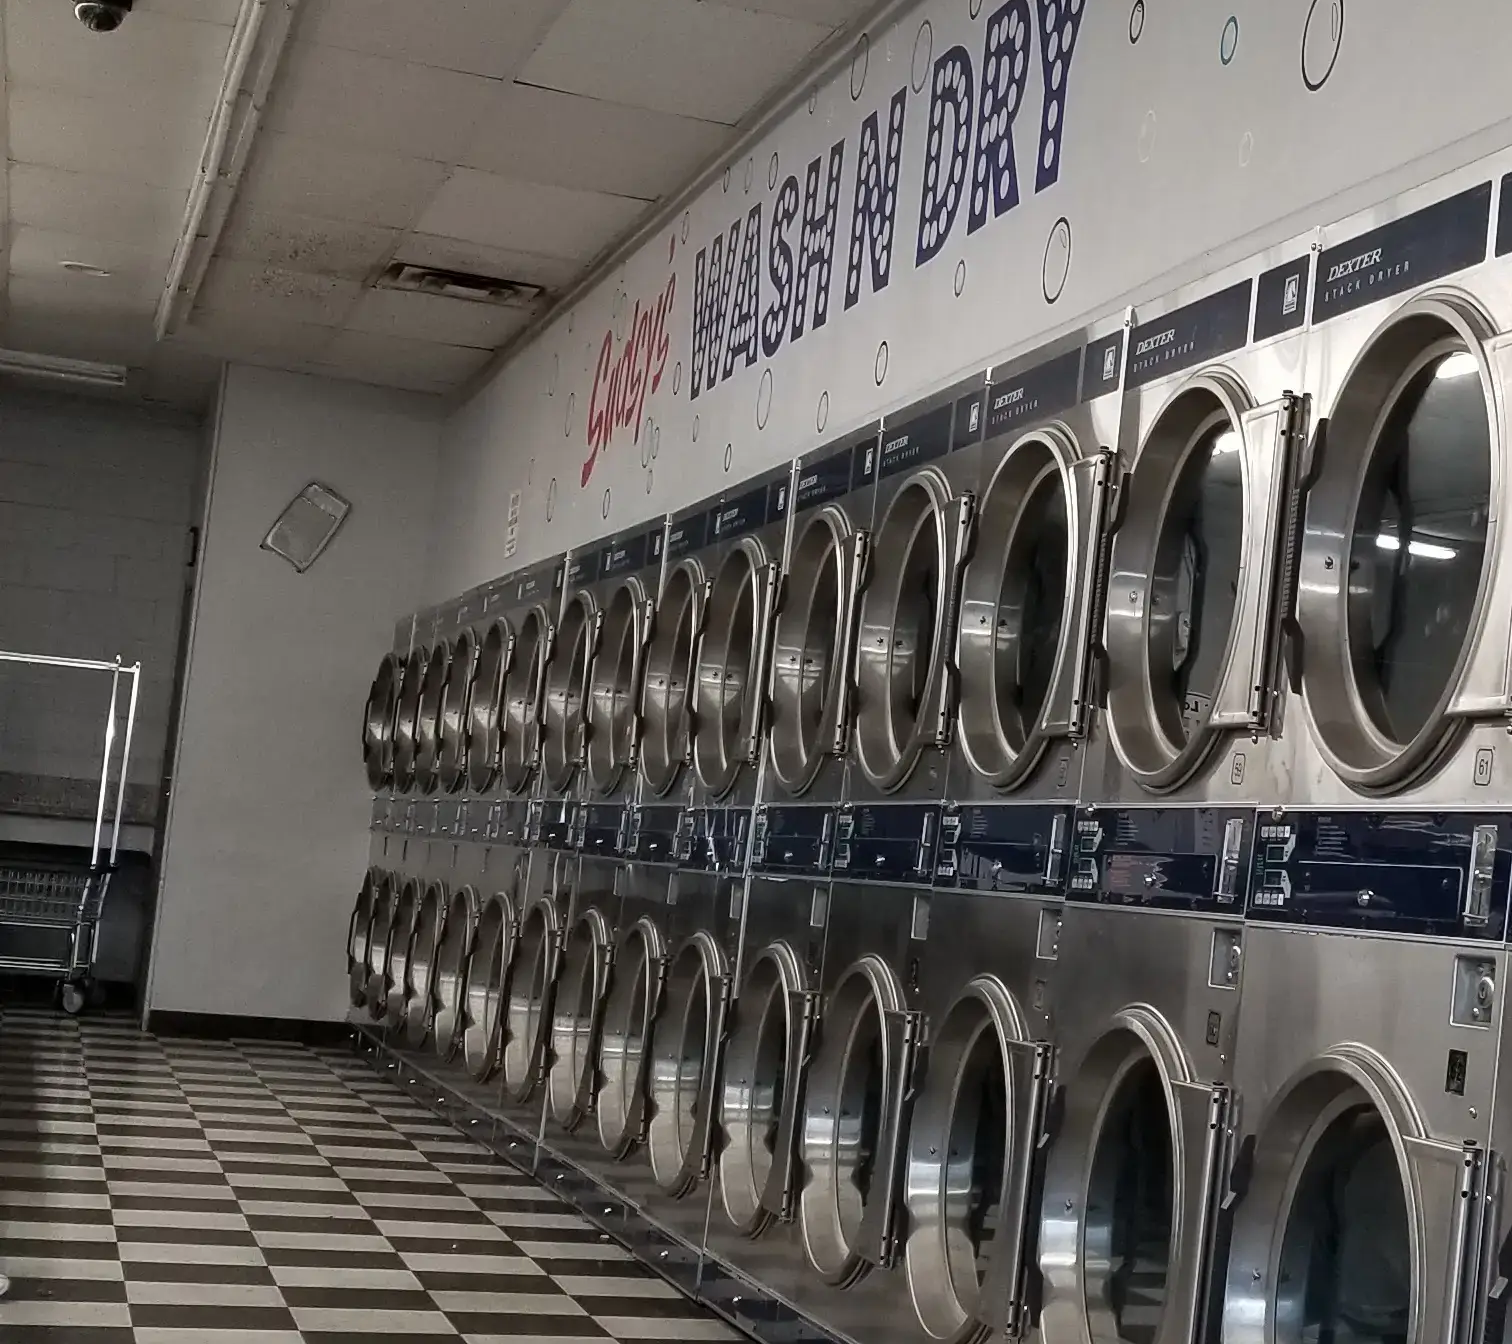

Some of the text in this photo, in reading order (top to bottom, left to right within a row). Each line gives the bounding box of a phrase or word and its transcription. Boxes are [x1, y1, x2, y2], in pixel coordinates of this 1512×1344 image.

[689, 137, 845, 400] WASH
[843, 85, 907, 312] N
[1324, 260, 1411, 302] STACK DRYER
[1326, 247, 1383, 284] DEXTER
[1135, 328, 1176, 356] DEXTER
[993, 387, 1024, 410] DEXTER
[1478, 758, 1489, 776] 61
